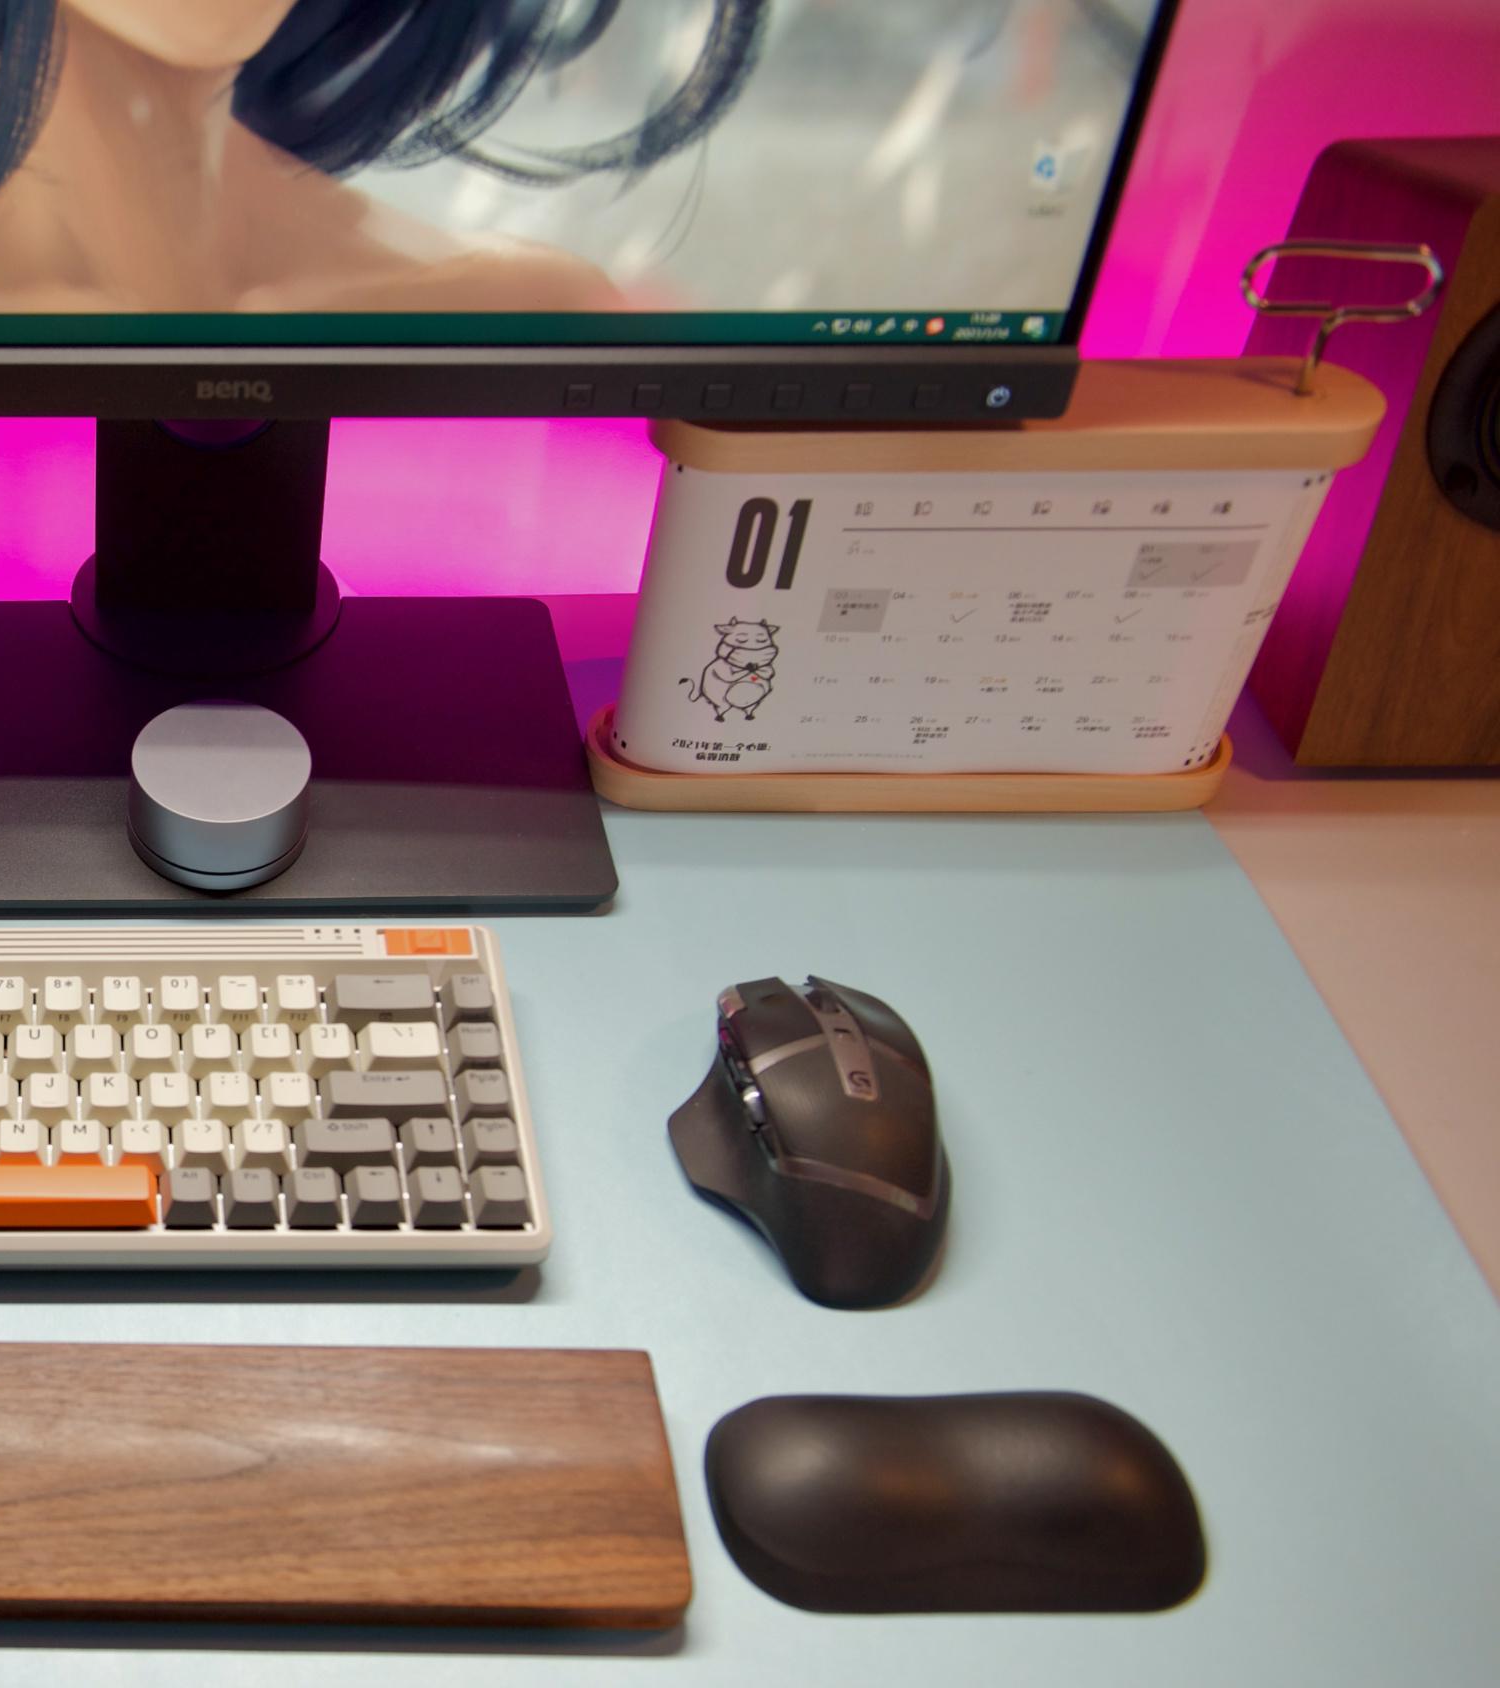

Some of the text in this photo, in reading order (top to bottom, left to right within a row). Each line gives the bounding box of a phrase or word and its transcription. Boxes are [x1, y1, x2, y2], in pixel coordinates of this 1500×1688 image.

[196, 380, 274, 402] BenQ
[725, 496, 814, 590] 01
[28, 1028, 42, 1040] U
[146, 1028, 159, 1040] O
[205, 1028, 217, 1039] P
[45, 1077, 55, 1088] J
[103, 1076, 116, 1088] K
[164, 1076, 174, 1088] L
[13, 1123, 26, 1134] N
[73, 1124, 88, 1135] M
